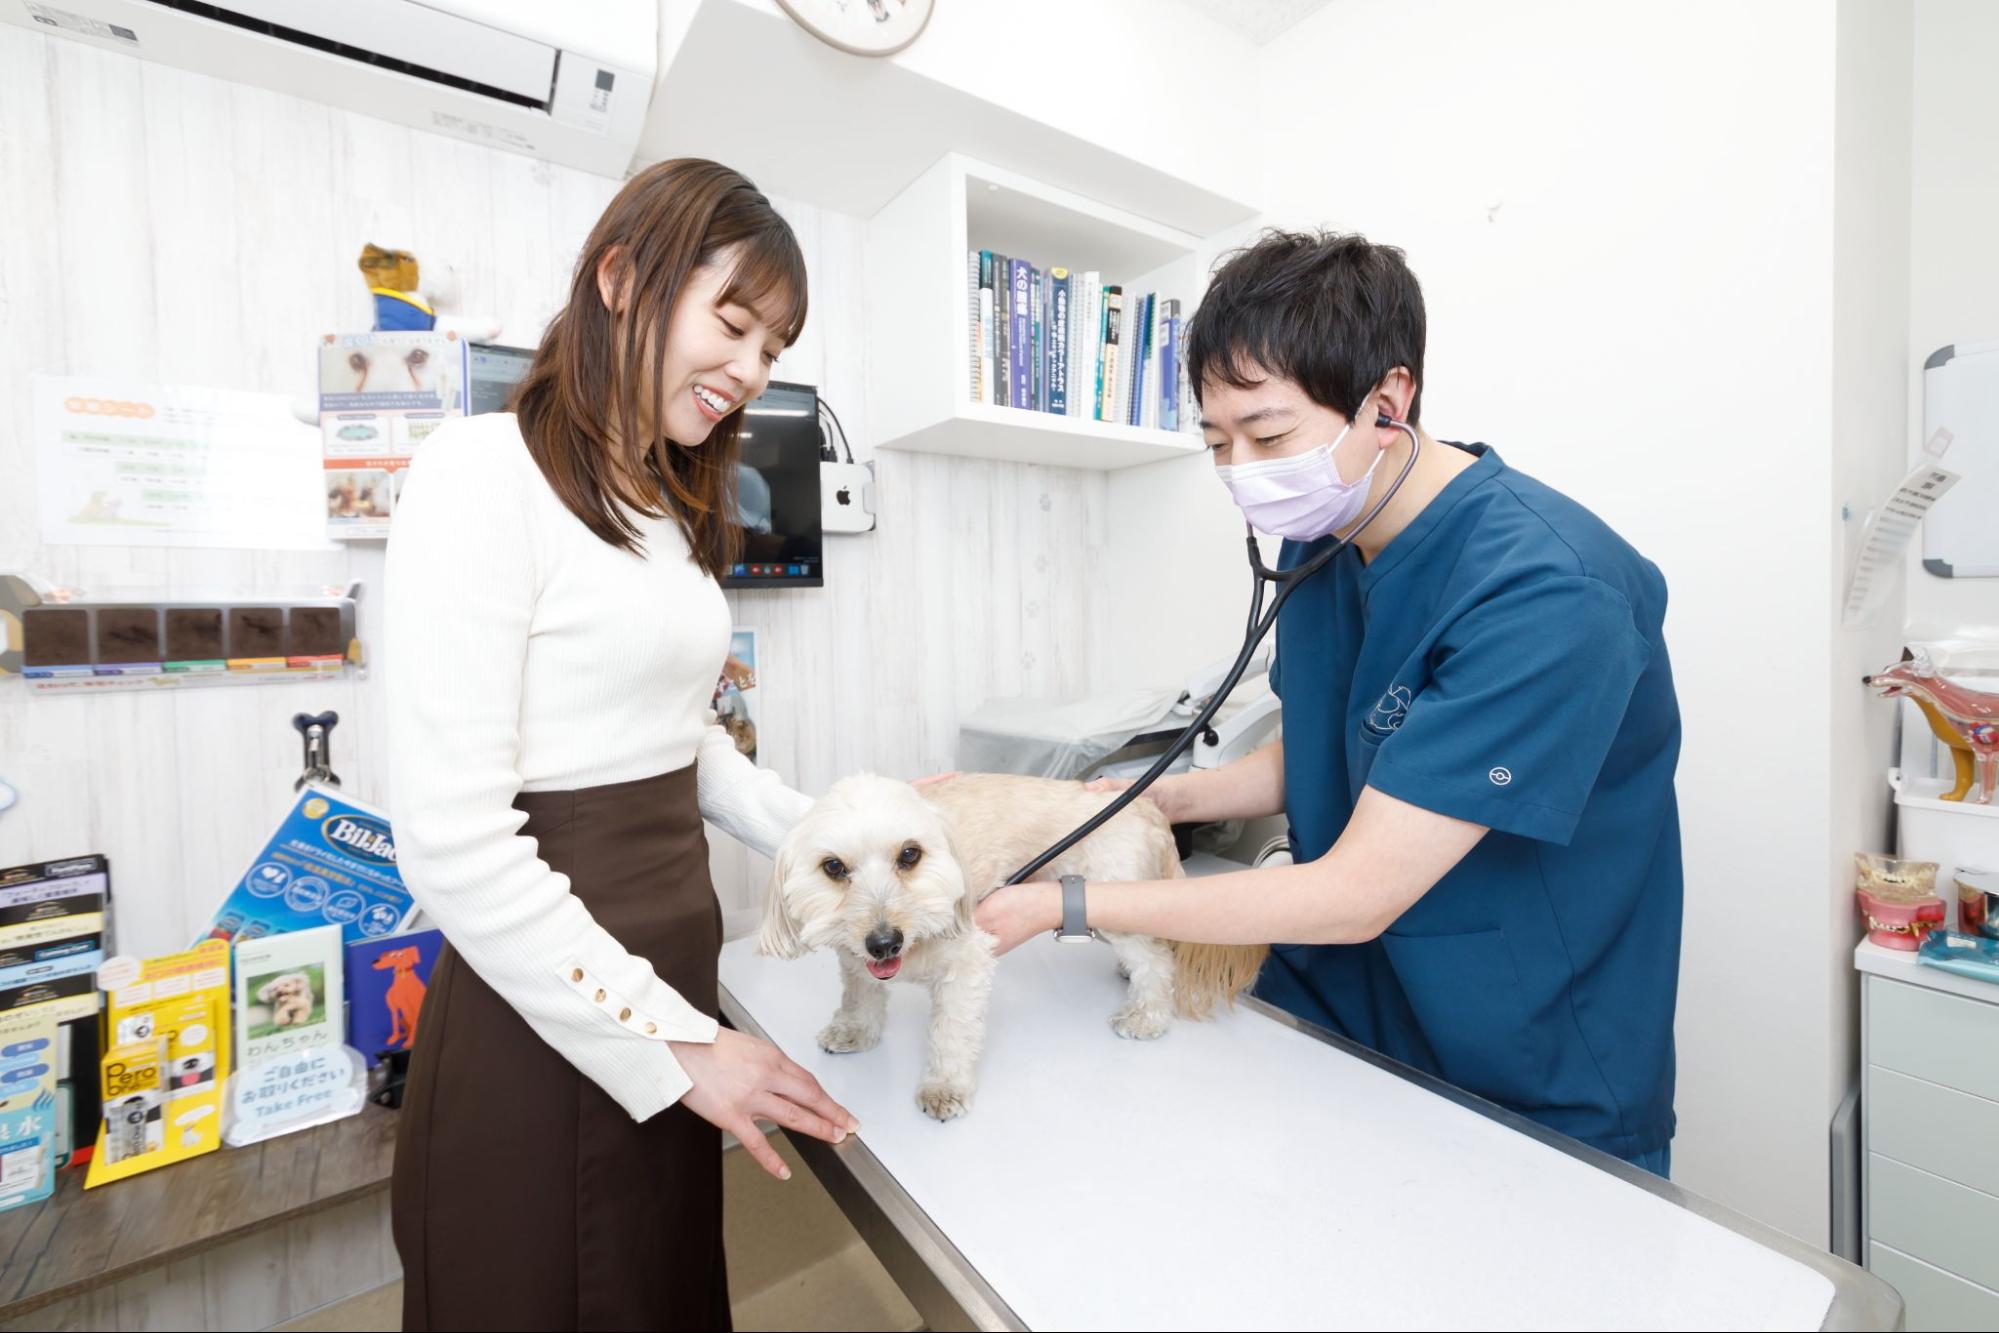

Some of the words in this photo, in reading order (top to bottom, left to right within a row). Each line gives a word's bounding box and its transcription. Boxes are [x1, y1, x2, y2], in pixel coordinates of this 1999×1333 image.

[263, 1056, 326, 1083] ご自由に
[240, 1067, 345, 1104] お取りください
[256, 1100, 293, 1117] Take
[297, 1089, 332, 1106] Free
